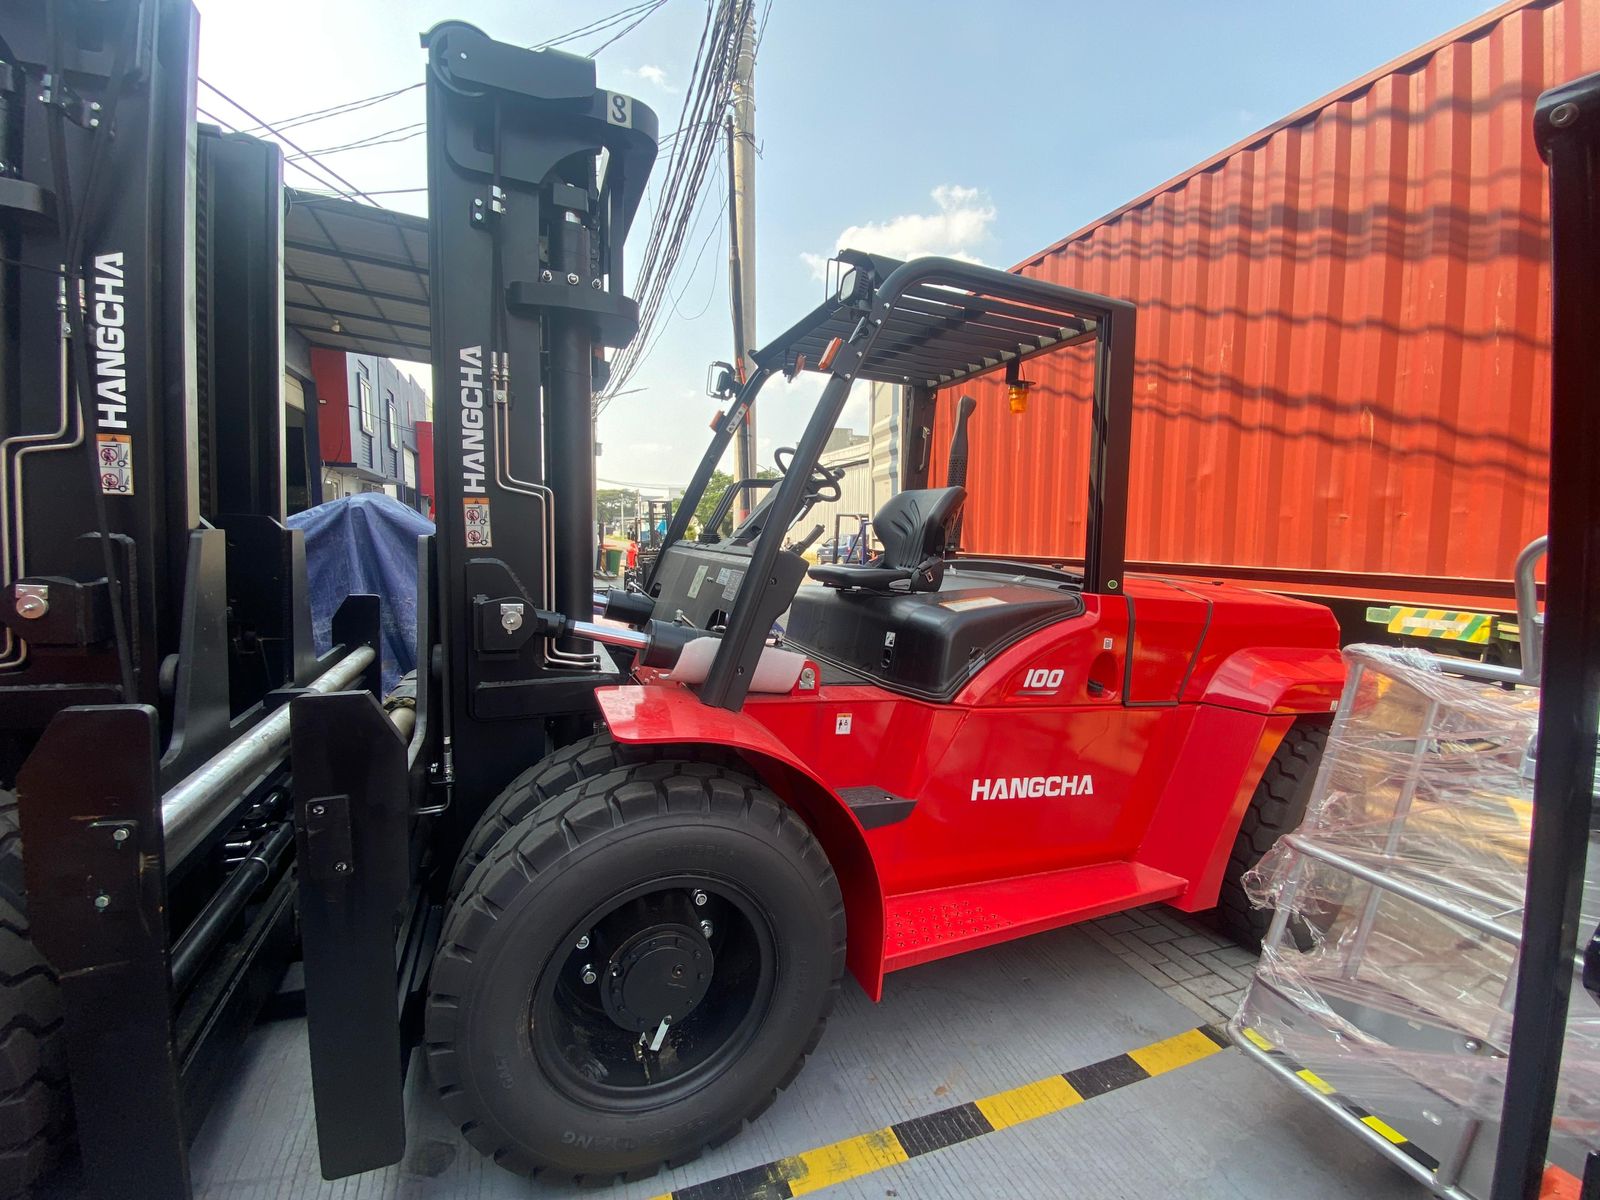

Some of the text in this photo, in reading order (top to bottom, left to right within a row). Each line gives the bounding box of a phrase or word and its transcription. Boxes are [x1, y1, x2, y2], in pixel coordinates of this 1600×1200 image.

[95, 252, 127, 428] HANGCHA
[460, 345, 486, 493] HANGCHA
[1023, 669, 1064, 688] 100
[971, 775, 1093, 801] HANGCHA
